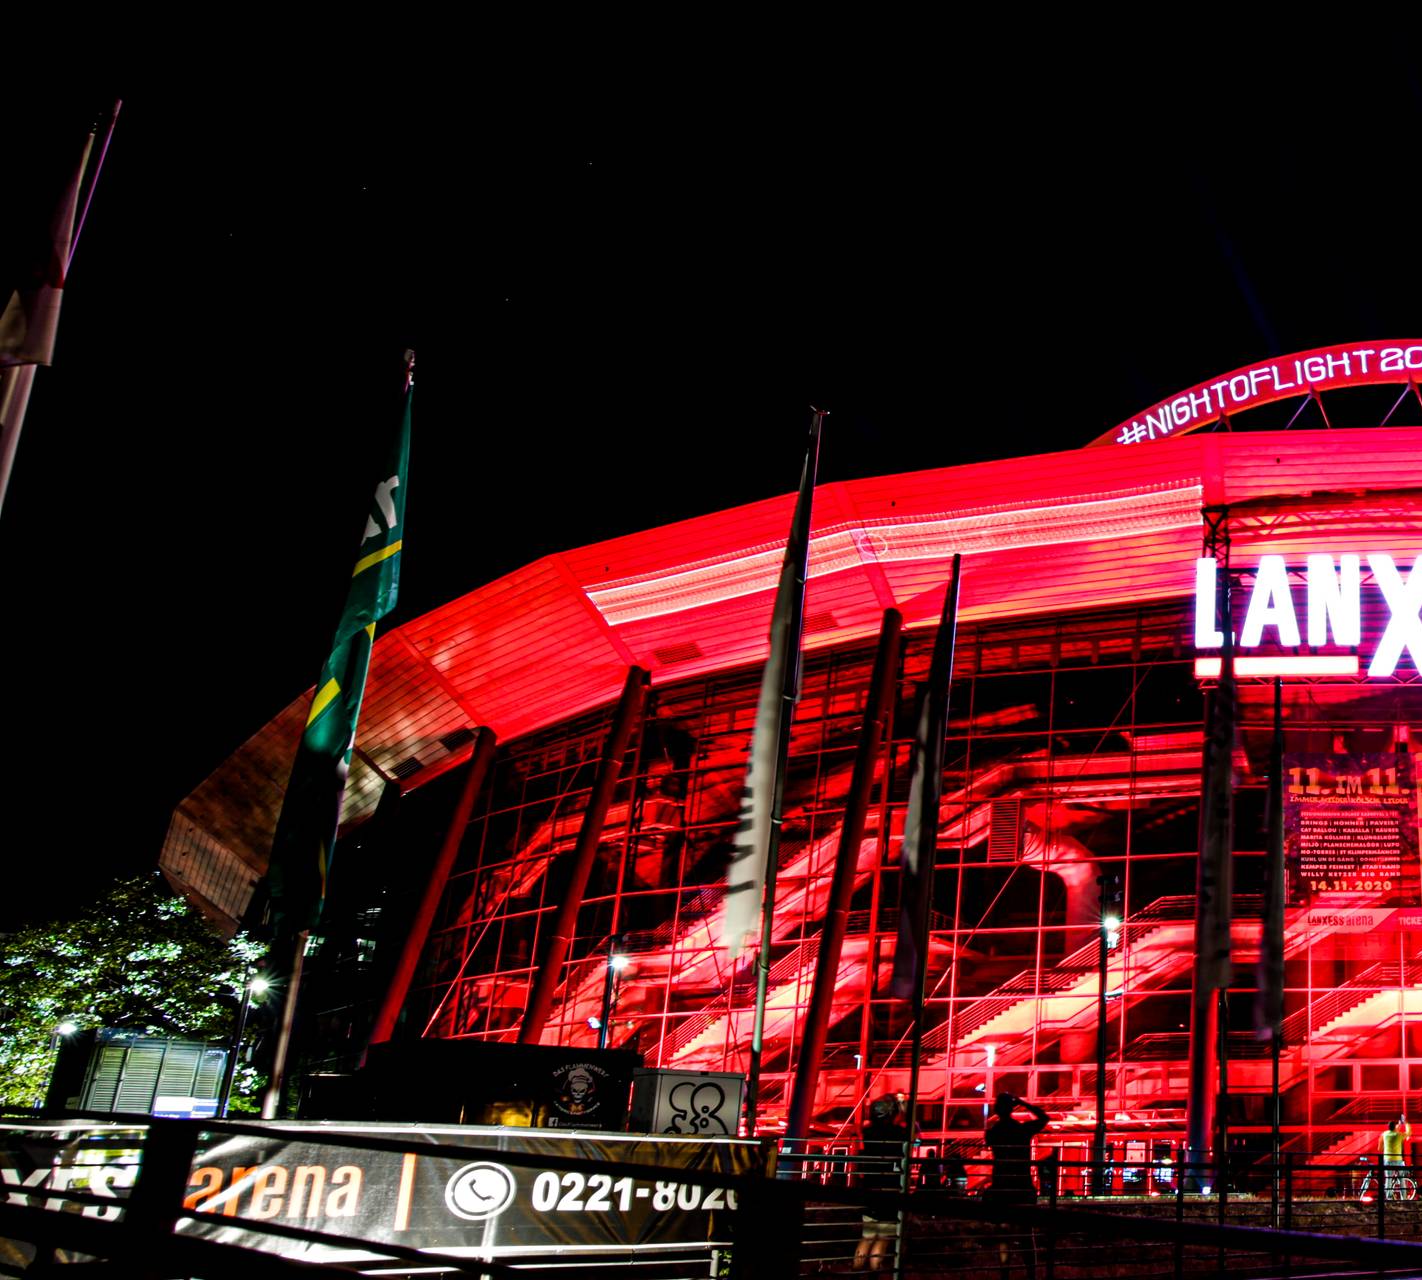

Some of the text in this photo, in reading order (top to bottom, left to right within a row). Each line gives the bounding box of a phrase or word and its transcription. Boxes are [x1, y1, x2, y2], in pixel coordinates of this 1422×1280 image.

[1288, 767, 1330, 795] 11.
[1335, 775, 1363, 795] IM
[1367, 767, 1410, 795] 11.
[1310, 880, 1392, 891] 14.11.2020
[1307, 915, 1345, 926] LANXESS
[182, 1164, 364, 1219] arena
